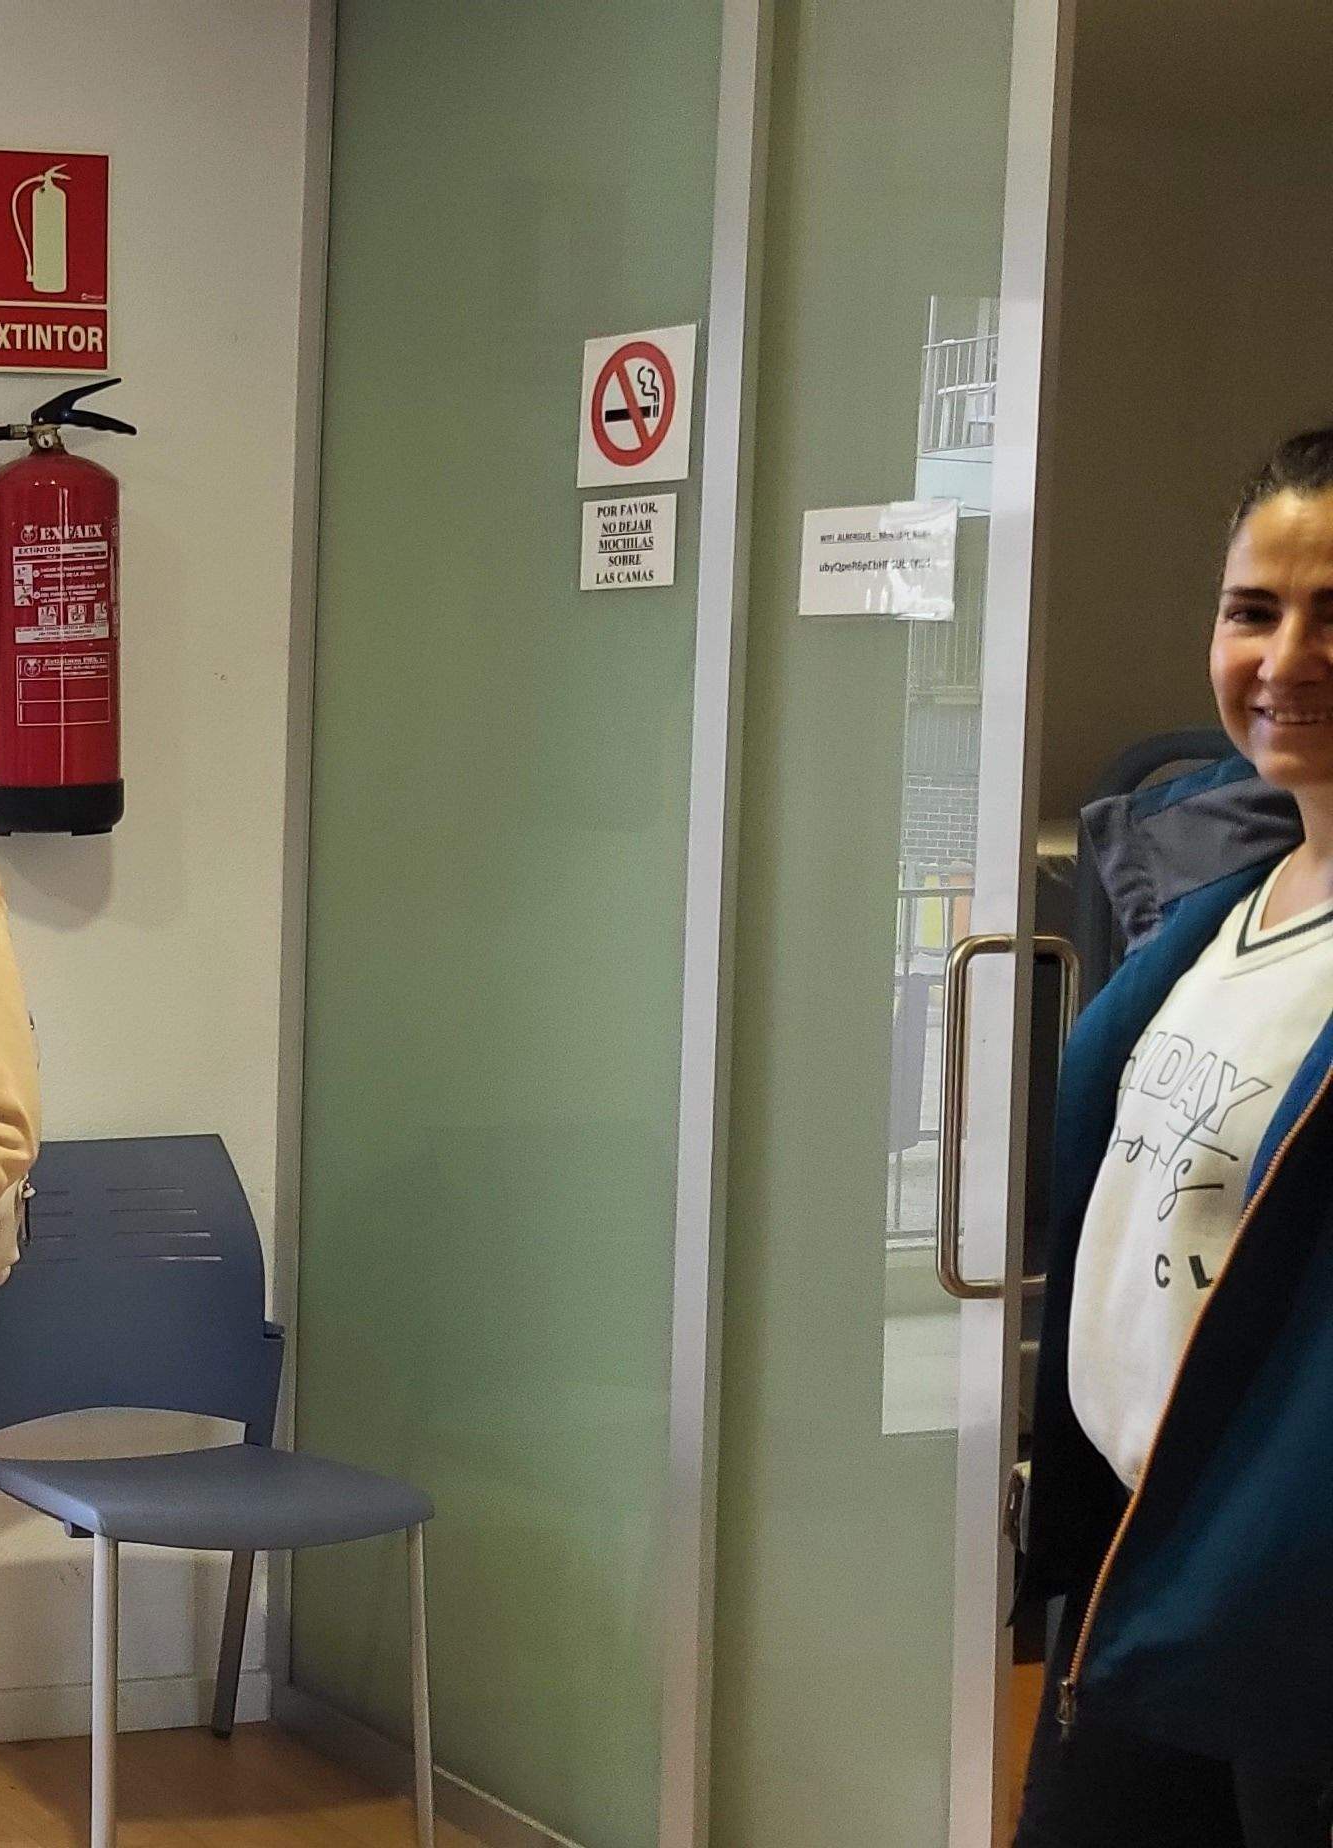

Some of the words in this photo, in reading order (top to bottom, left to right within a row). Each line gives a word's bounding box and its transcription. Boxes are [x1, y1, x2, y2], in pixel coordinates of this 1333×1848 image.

[597, 505, 617, 518] POR
[39, 524, 102, 541] EXFAEX
[601, 521, 617, 534] NO
[618, 519, 652, 533] DEJAR
[598, 536, 654, 551] MOCHILAS
[608, 553, 643, 567] SOBRE
[596, 572, 615, 584] LAS
[617, 569, 654, 583] CAMAS
